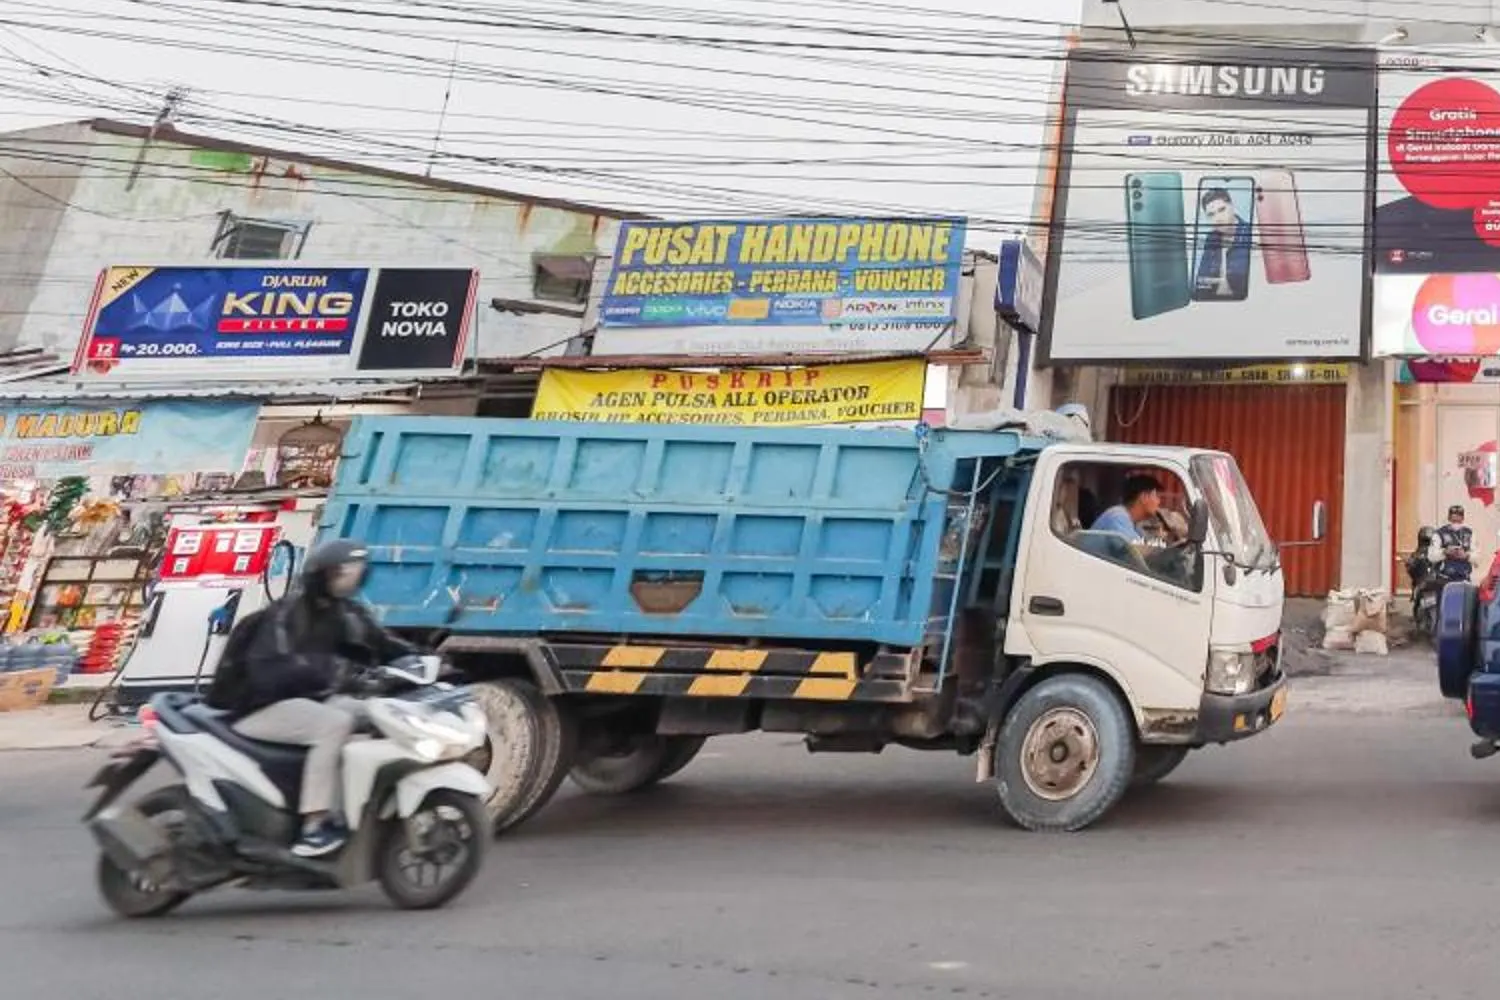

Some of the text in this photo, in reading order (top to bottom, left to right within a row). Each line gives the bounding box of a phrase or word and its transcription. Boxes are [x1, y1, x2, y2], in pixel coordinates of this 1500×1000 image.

[1126, 62, 1325, 96] SAMSUNG
[620, 222, 950, 266] PUSAT HANDPHONE
[110, 268, 141, 293] NEW
[262, 275, 328, 288] DJARUM
[612, 268, 947, 296] ACCESORIES PERDANA VOUCHER
[221, 292, 353, 316] KING
[390, 301, 449, 317] TOKO
[1427, 303, 1498, 326] Gerai
[242, 319, 326, 330] FILTER
[382, 320, 446, 338] NOVIA
[95, 343, 114, 356] 12
[651, 370, 821, 390] PUSKRIP
[590, 385, 870, 408] AGEN PULSA ALL OPERATOR
[838, 401, 916, 418] VOUCHER
[16, 410, 141, 439] MADURA
